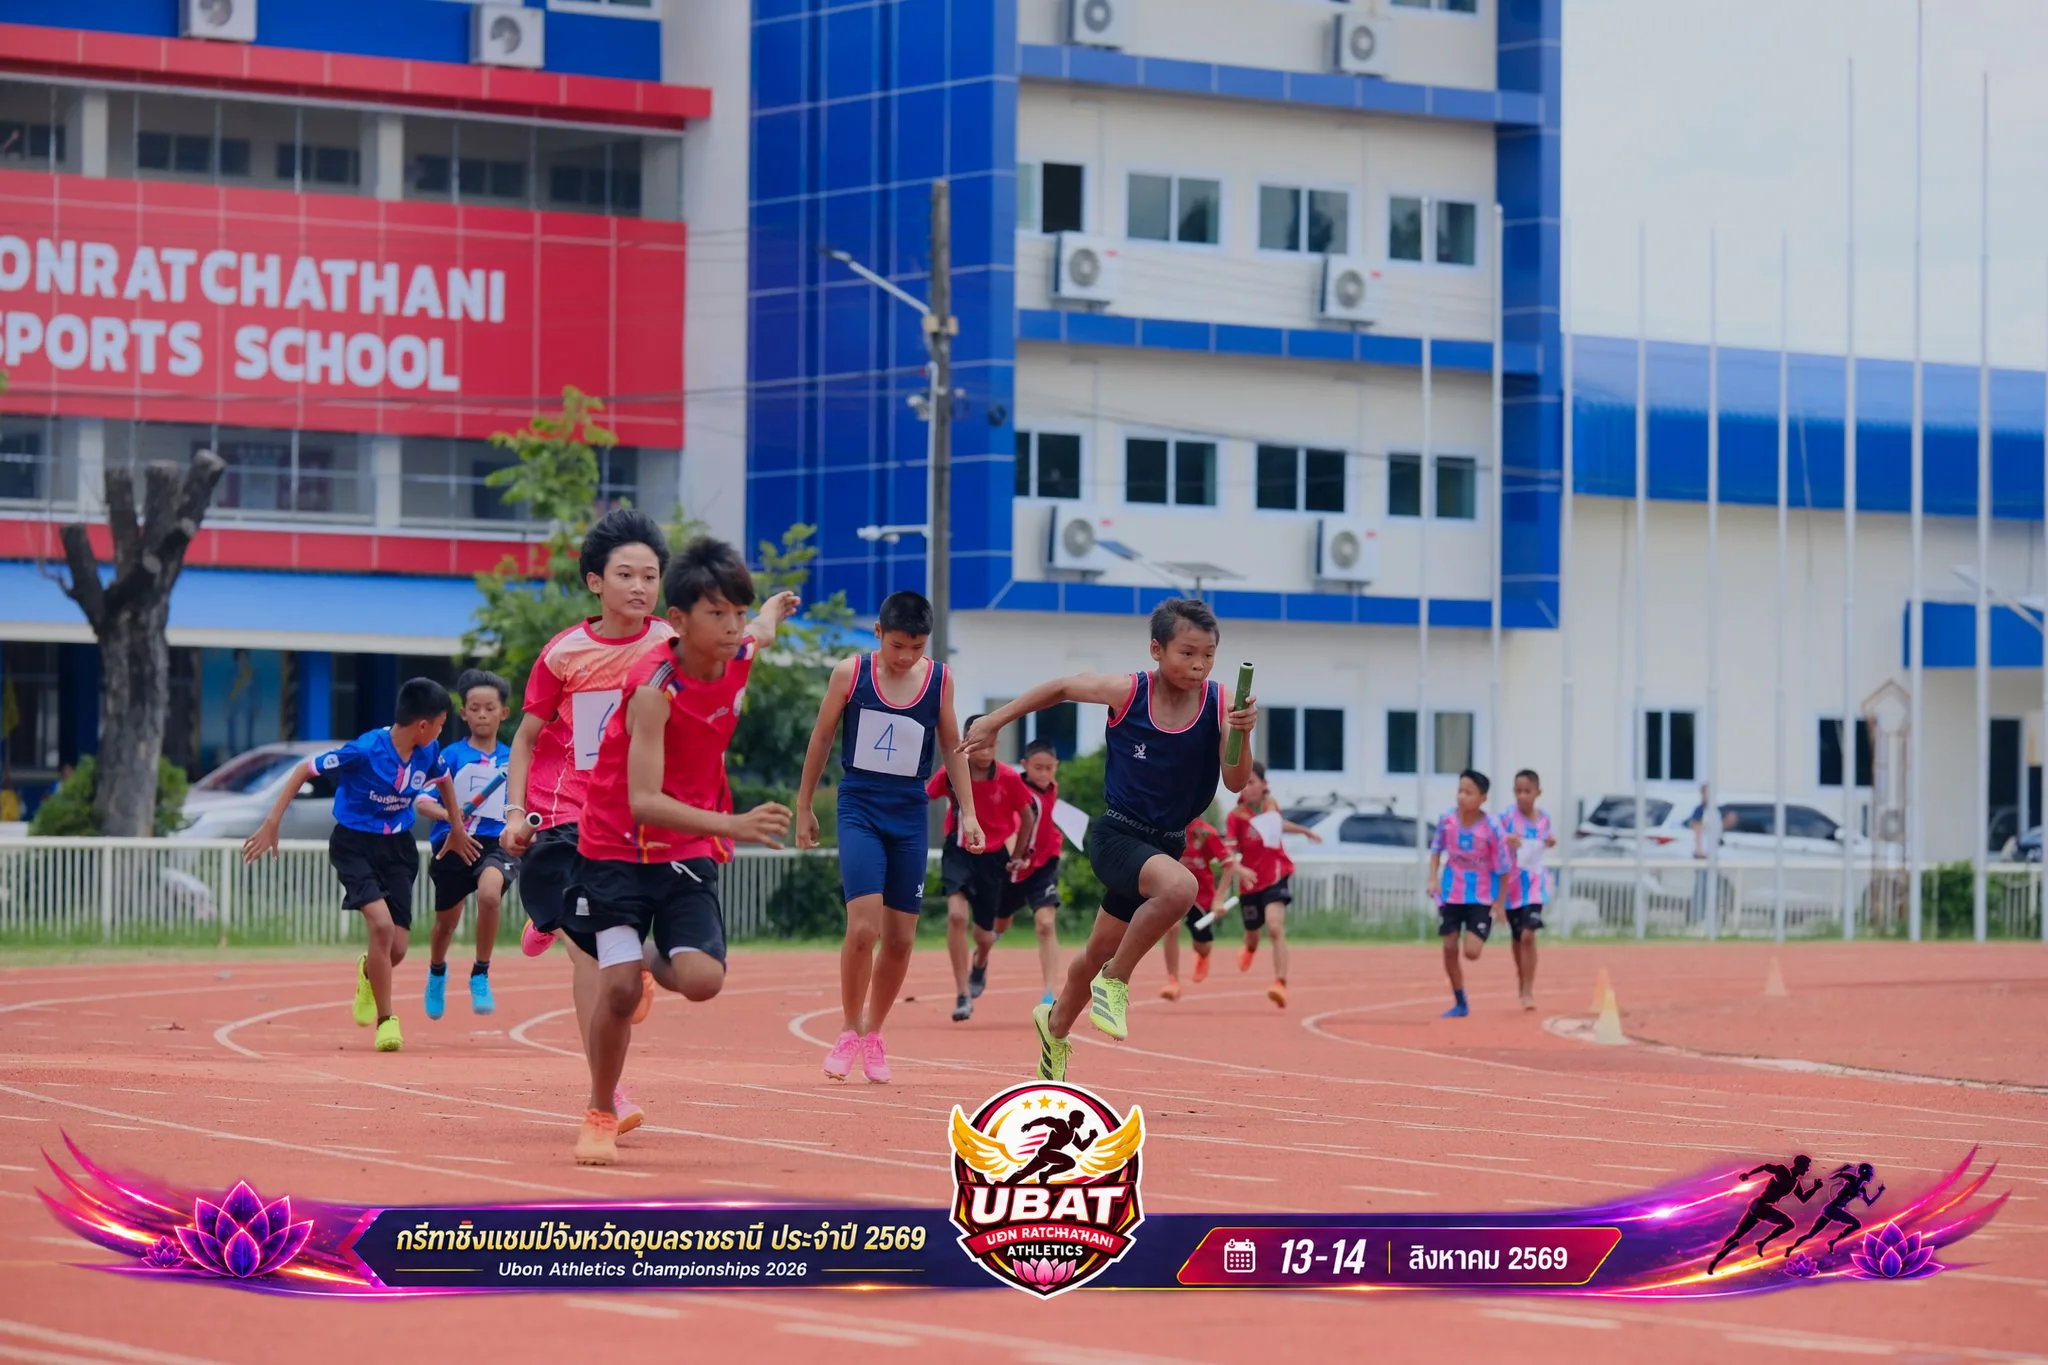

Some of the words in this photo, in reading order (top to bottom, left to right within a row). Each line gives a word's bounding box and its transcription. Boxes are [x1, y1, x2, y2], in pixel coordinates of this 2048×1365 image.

[0, 311, 202, 376] PORTS
[234, 325, 460, 392] SCHOOL
[874, 723, 897, 761] 4
[1107, 808, 1159, 835] COMBAT
